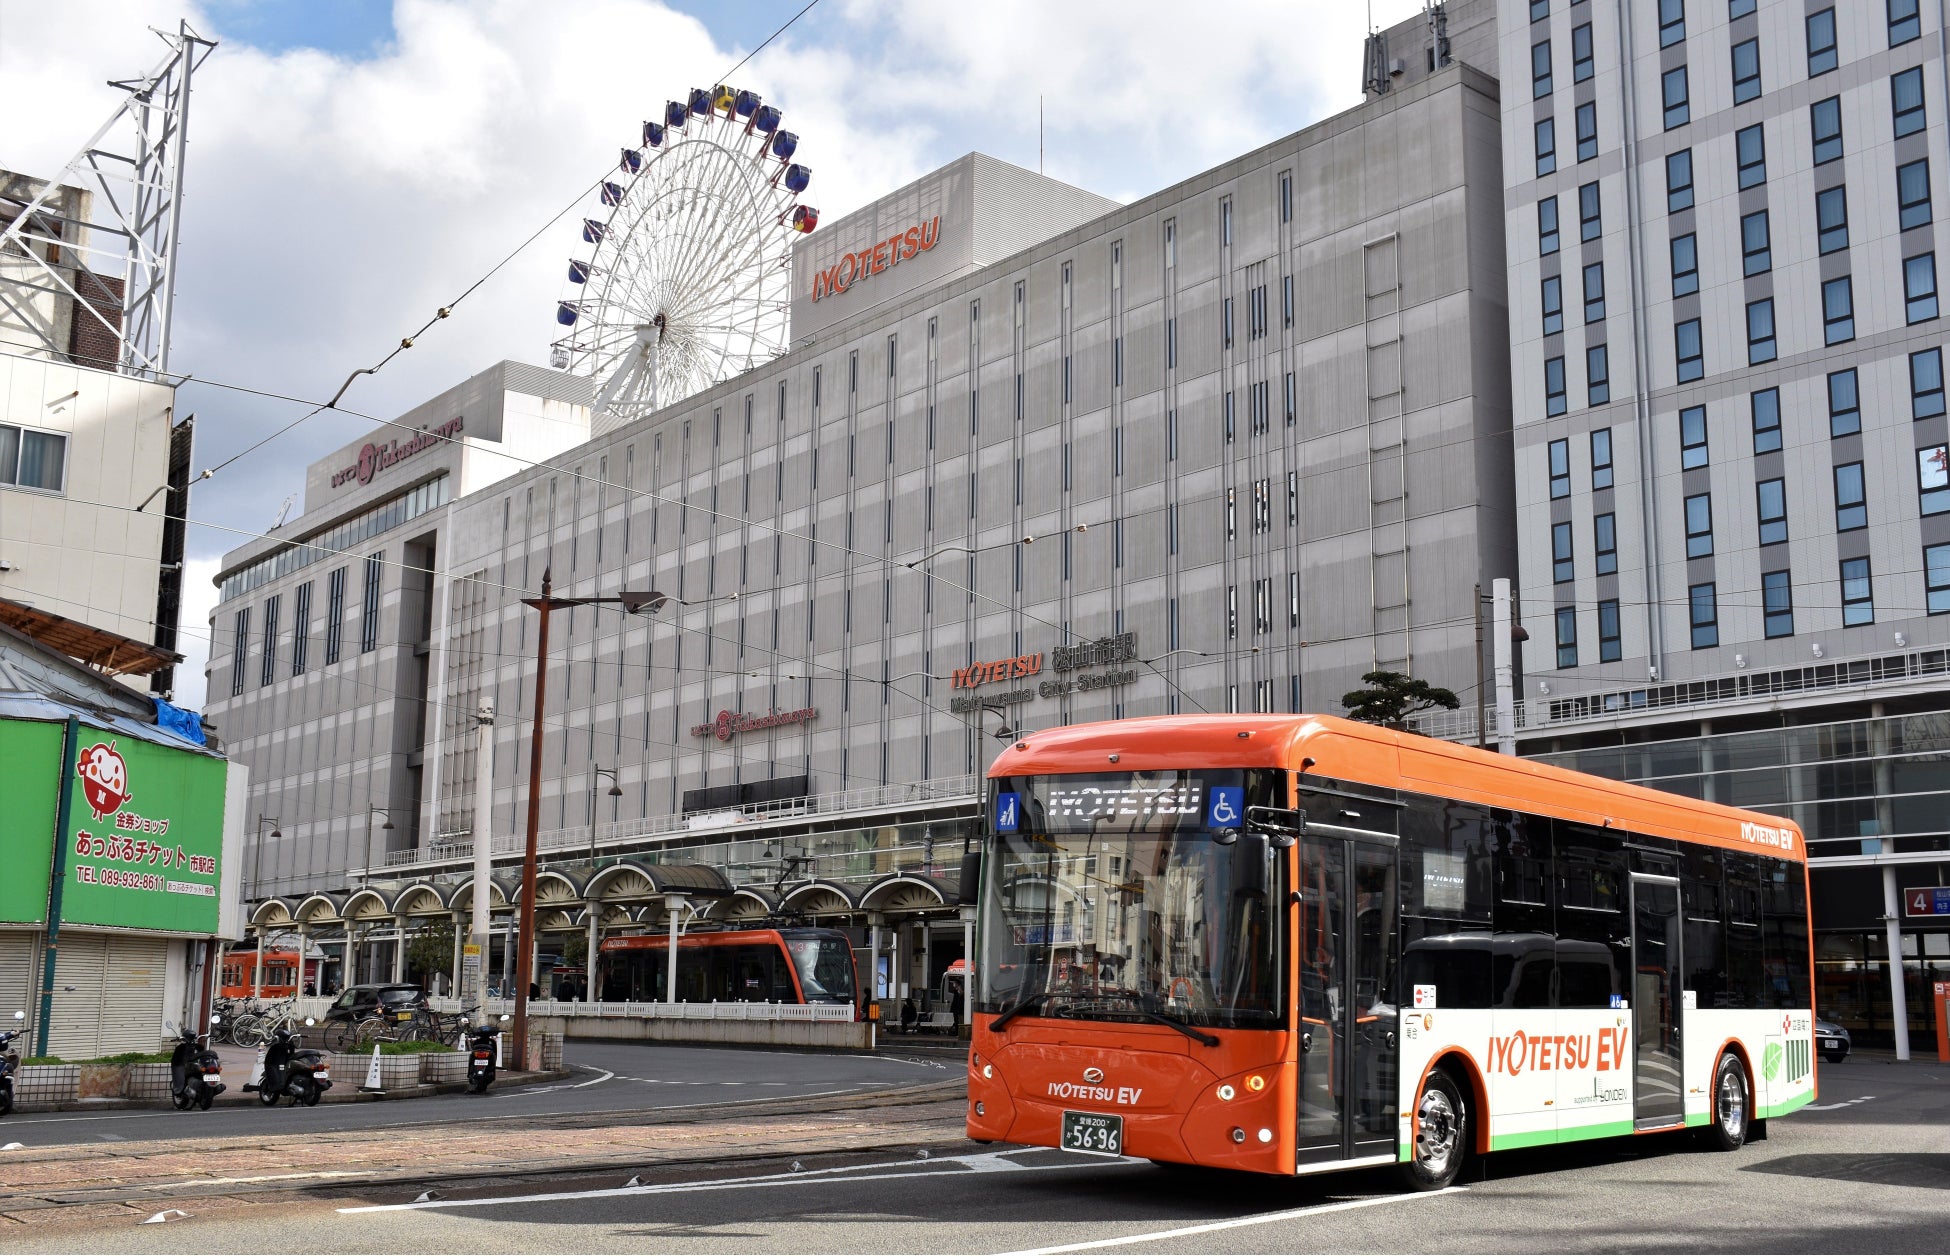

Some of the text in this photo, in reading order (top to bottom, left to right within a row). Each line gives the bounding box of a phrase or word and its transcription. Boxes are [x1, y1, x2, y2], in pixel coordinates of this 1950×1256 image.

[811, 215, 941, 303] IYOTETSU
[951, 652, 1043, 689] IYOTETSU
[1039, 679, 1070, 698] City
[1077, 669, 1137, 691] Station
[116, 812, 169, 834] 金券ショップ
[1741, 822, 1793, 850] IYOTETSU EV
[76, 830, 215, 874] あっぷるチケット 市駅店
[77, 866, 164, 891] TEL 089-932-8611
[1913, 893, 1927, 911] 4
[1487, 1027, 1628, 1076] IYOTETSU EV
[1047, 1082, 1142, 1105] IYOTETSU EV
[1073, 1126, 1117, 1150] 56-96
